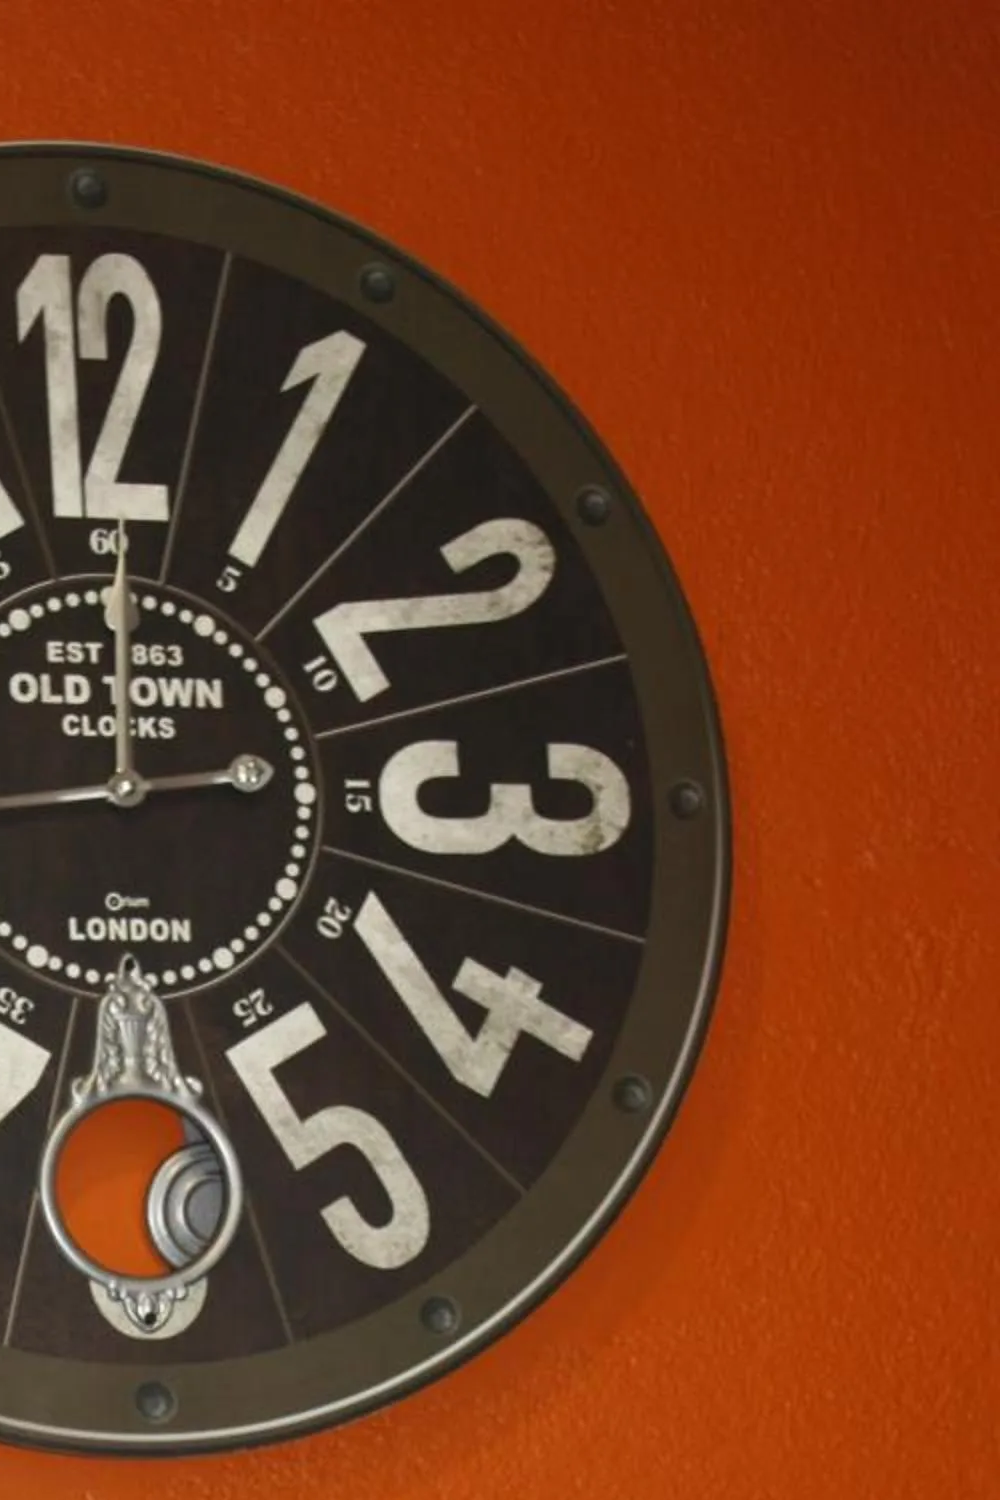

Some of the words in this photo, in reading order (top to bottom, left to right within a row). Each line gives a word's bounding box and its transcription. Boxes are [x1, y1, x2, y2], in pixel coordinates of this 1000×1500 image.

[16, 253, 169, 522] 12
[228, 330, 367, 568] 1
[89, 528, 129, 555] 60
[216, 566, 242, 592] 5
[312, 517, 558, 702] 2
[46, 642, 103, 663] EST
[131, 644, 184, 667] 863
[303, 654, 338, 692] 10
[9, 673, 91, 704] OLD
[62, 714, 176, 739] CLOKS
[345, 778, 371, 813] 15
[379, 740, 630, 856] 3
[68, 917, 192, 942] LONDON
[317, 897, 352, 939] 20
[233, 988, 273, 1027] 25
[353, 891, 593, 1098] 4
[225, 1001, 430, 1269] 5
